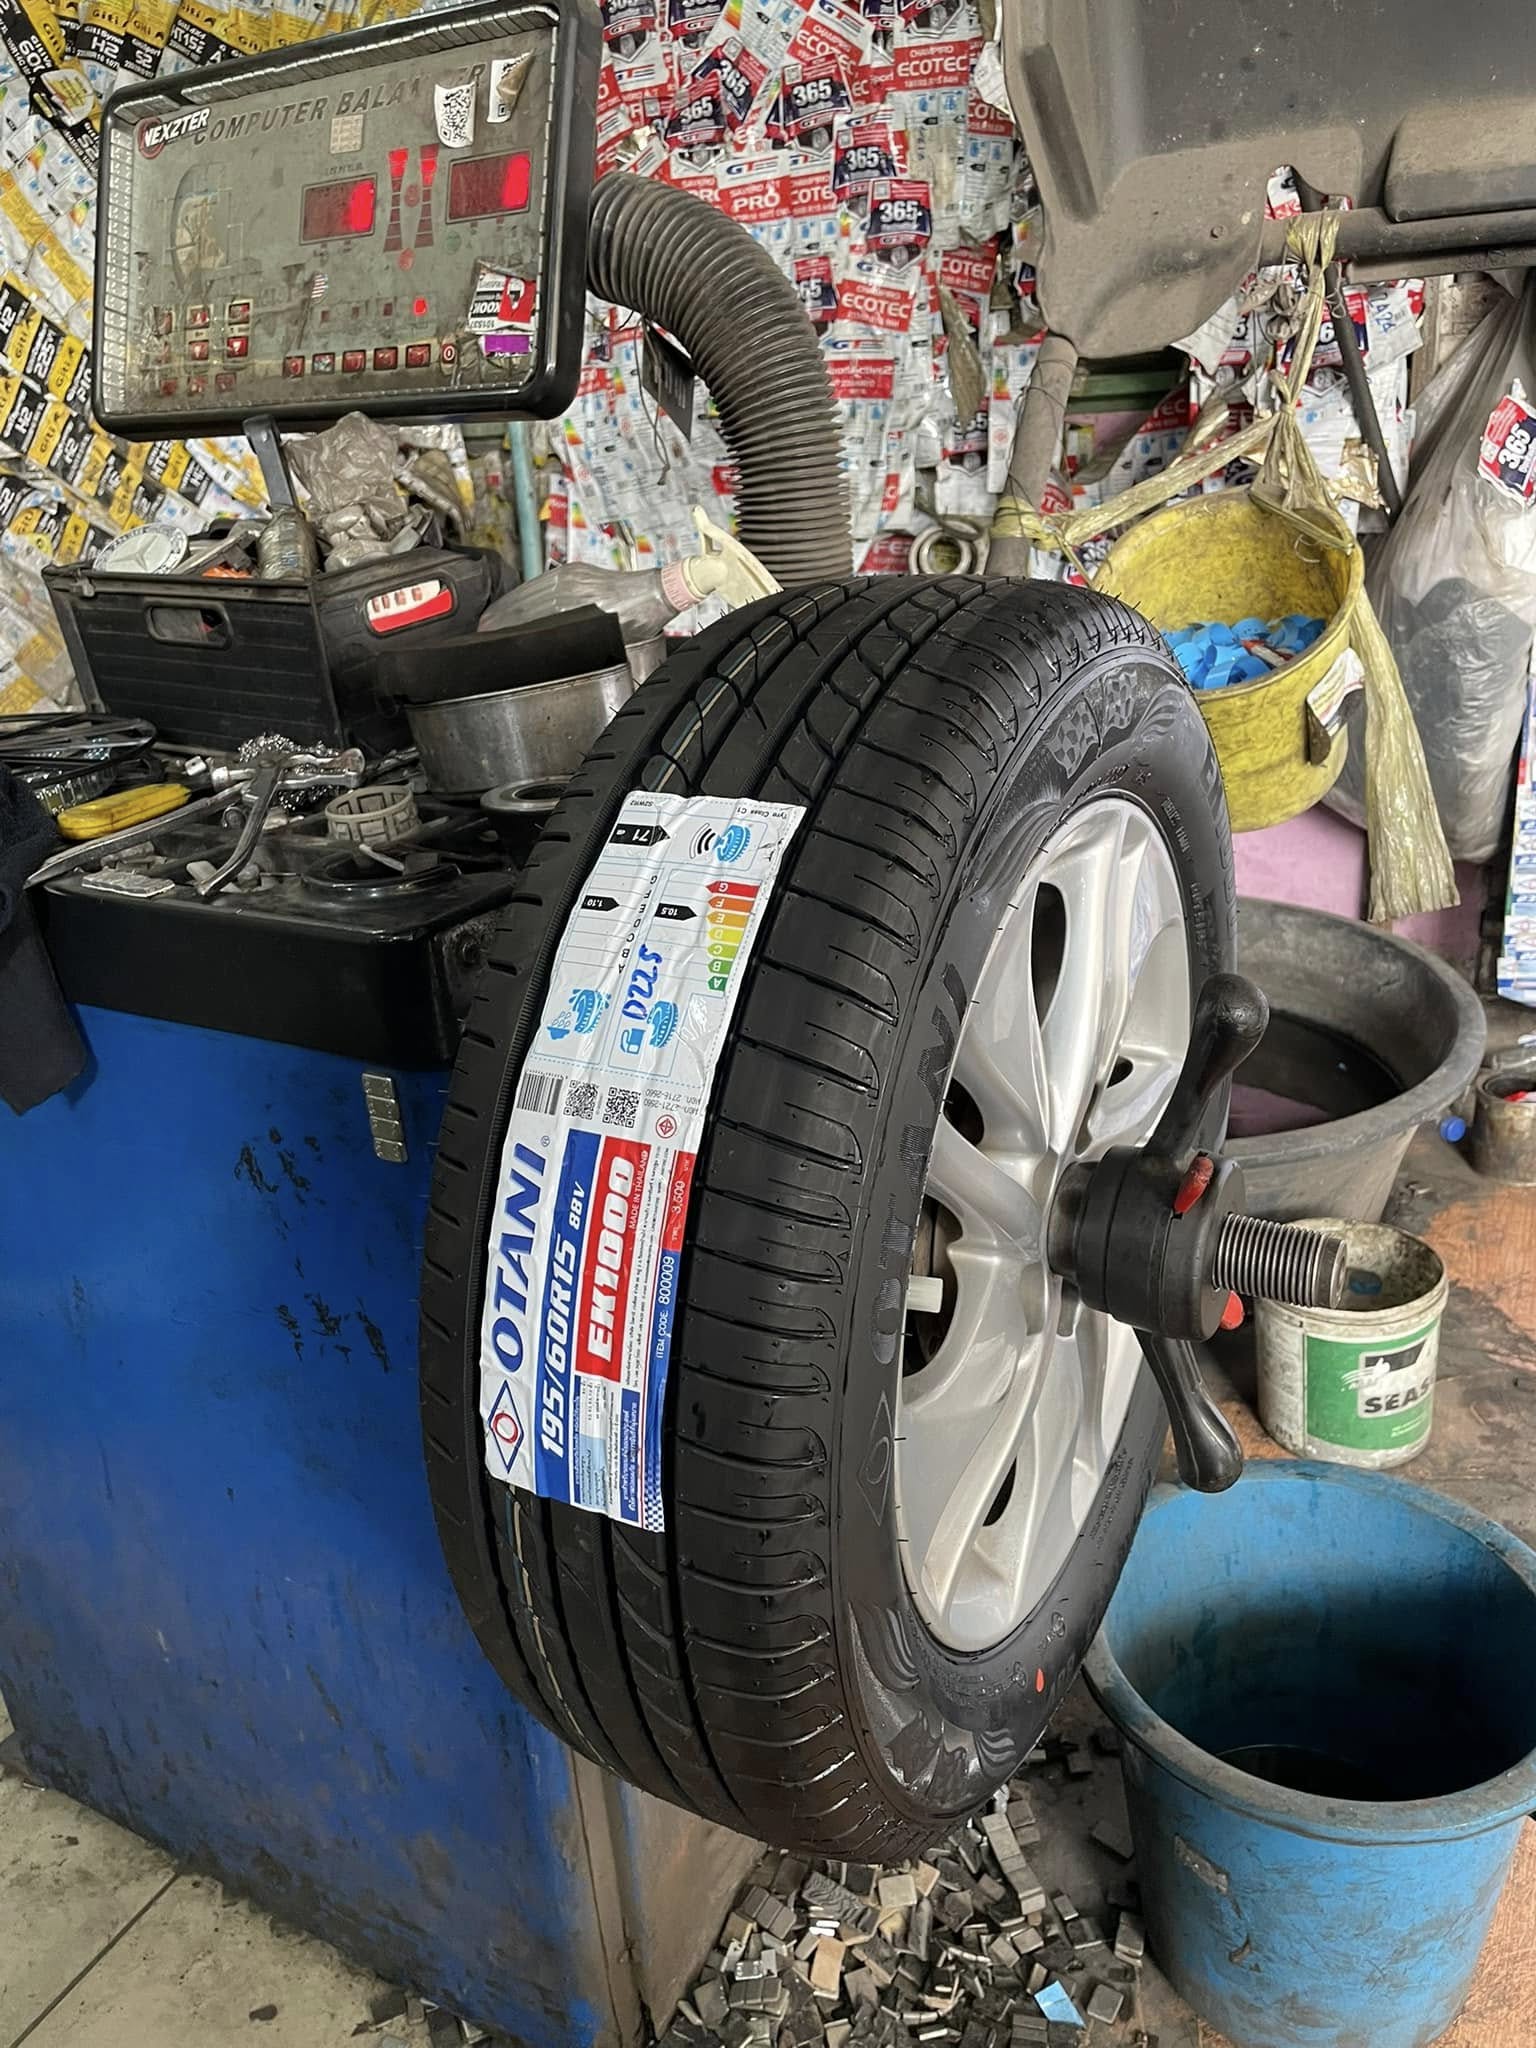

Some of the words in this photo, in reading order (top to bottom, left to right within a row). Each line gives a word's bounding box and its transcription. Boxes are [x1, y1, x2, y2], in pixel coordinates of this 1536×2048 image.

[91, 36, 120, 59] H2
[135, 49, 153, 69] S2
[897, 55, 968, 78] ECOTEC
[721, 59, 751, 98] 365
[792, 78, 833, 107] 365
[680, 95, 713, 124] 365
[145, 107, 211, 147] NEXZTER
[193, 100, 329, 146] COMPUTER
[846, 147, 880, 171] 365
[732, 192, 781, 213] PRO
[880, 200, 919, 223] 365
[841, 293, 910, 318] ECOTEC
[1498, 422, 1531, 470] 365
[736, 807, 748, 815] C1
[632, 828, 650, 842] 71
[718, 883, 729, 892] G
[586, 898, 603, 907] 1.10
[661, 907, 679, 916] 10.5
[715, 899, 725, 908] F
[715, 914, 725, 923] E
[713, 945, 723, 955] C
[712, 961, 722, 971] B
[713, 978, 722, 988] A
[635, 1150, 649, 1198] THAILAND
[633, 1198, 641, 1208] IN
[628, 1209, 640, 1230] MADE
[493, 1143, 546, 1373] OTANI
[588, 1156, 634, 1362] EK1000
[658, 1256, 675, 1305] 800009
[540, 1232, 577, 1459] 195/60R15
[569, 1181, 585, 1230] 88V
[656, 1338, 666, 1359] ITEM
